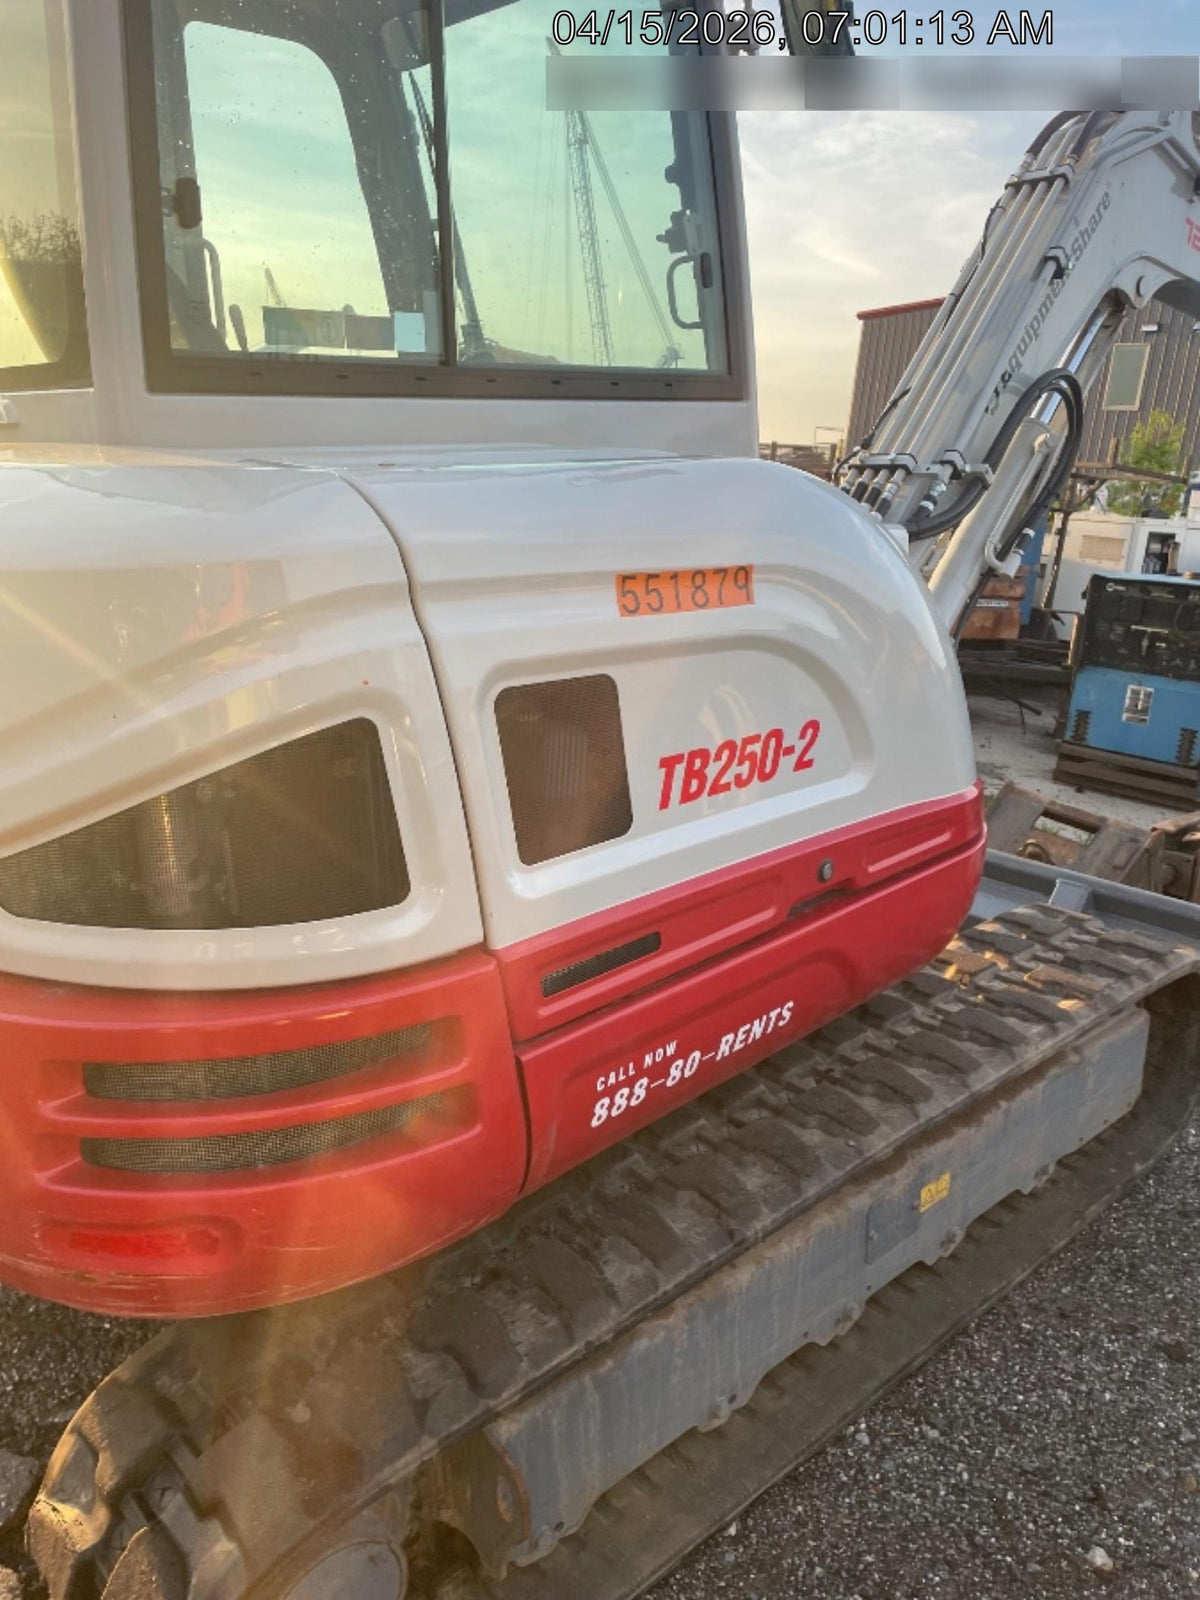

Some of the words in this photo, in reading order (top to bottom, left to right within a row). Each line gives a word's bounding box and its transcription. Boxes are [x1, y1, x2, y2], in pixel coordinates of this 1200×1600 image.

[1000, 189, 1112, 390] EquipmeShare
[621, 566, 751, 614] 551879
[659, 719, 821, 811] TB250-2
[590, 1000, 794, 1128] 888-80-RENTS
[596, 1062, 635, 1092] CALL
[643, 1040, 678, 1069] NOW
